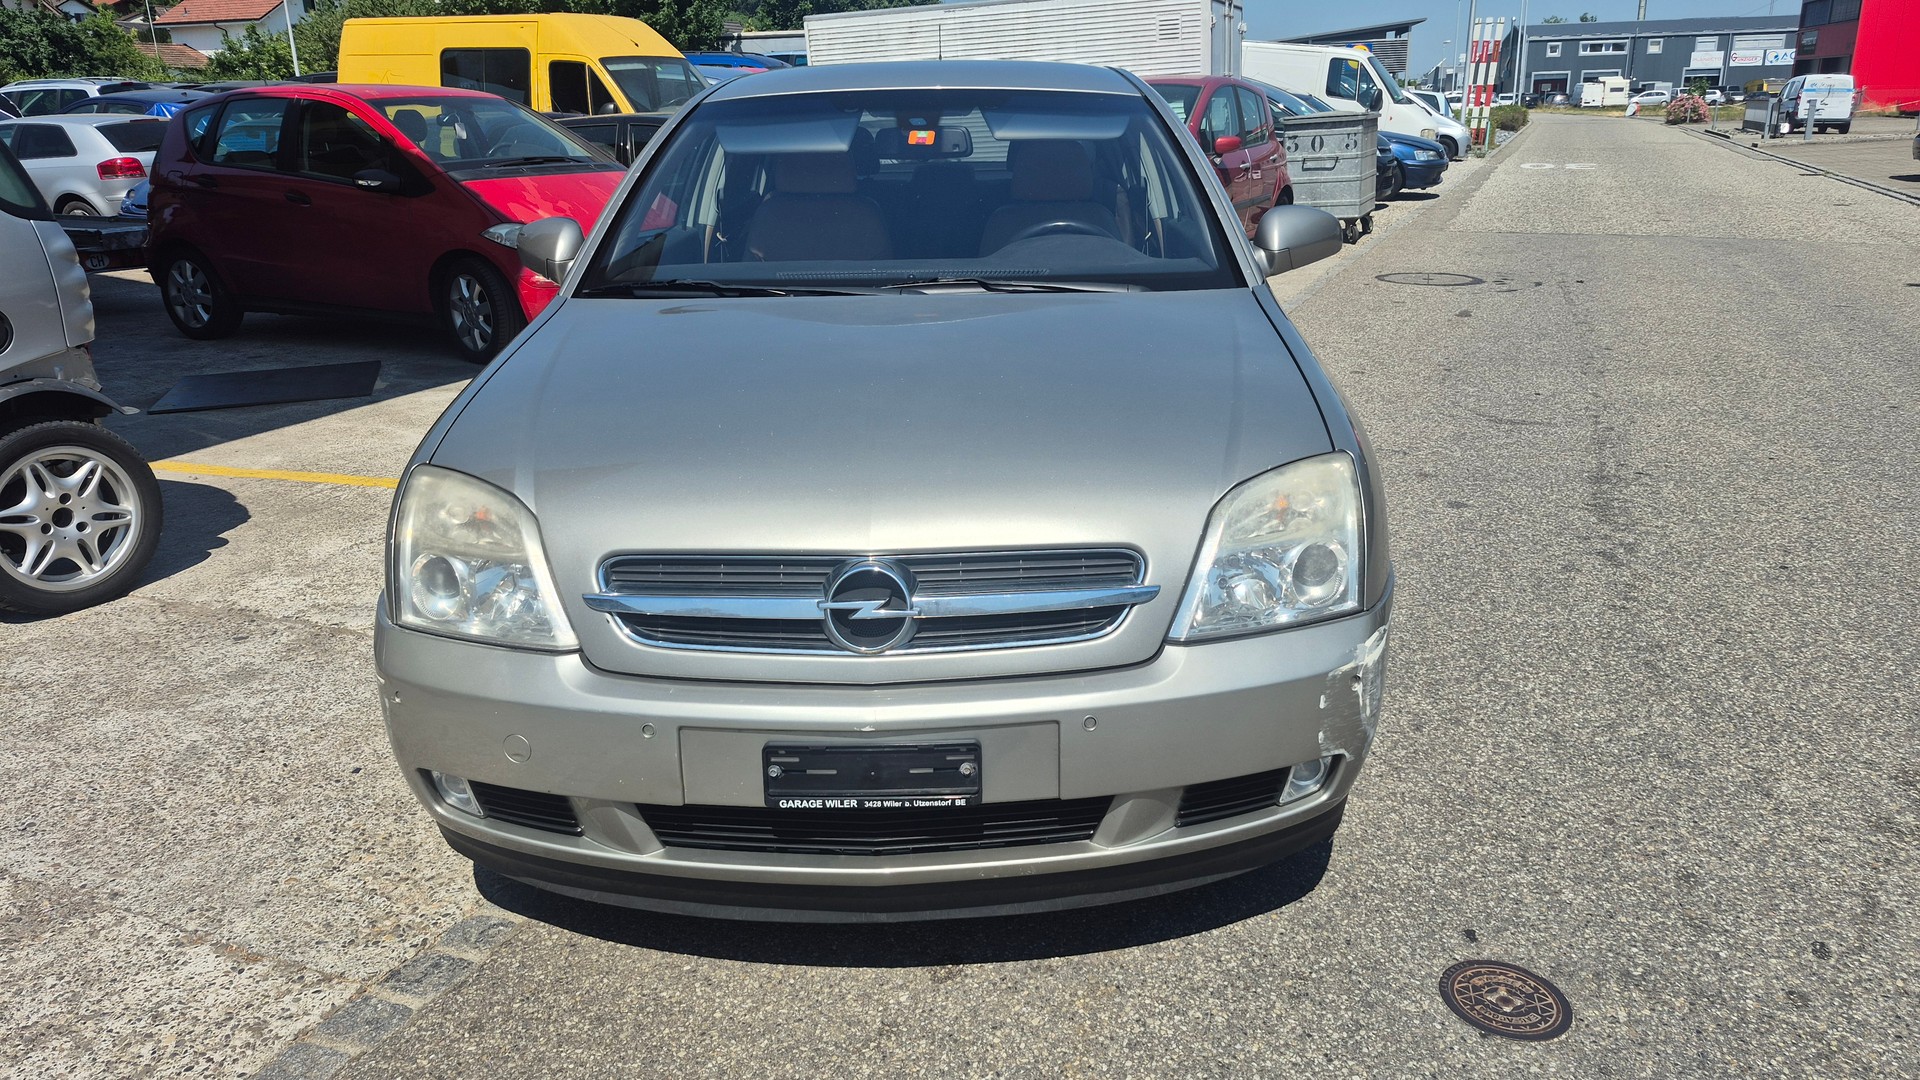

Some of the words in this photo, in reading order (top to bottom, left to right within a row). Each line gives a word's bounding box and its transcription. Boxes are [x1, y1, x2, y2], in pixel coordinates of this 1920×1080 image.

[90, 255, 105, 268] CH
[779, 799, 823, 809] GARAGE
[825, 799, 858, 808] WILER
[864, 800, 881, 808] 3428
[913, 799, 951, 807] Utzenstorf
[955, 798, 966, 806] BE
